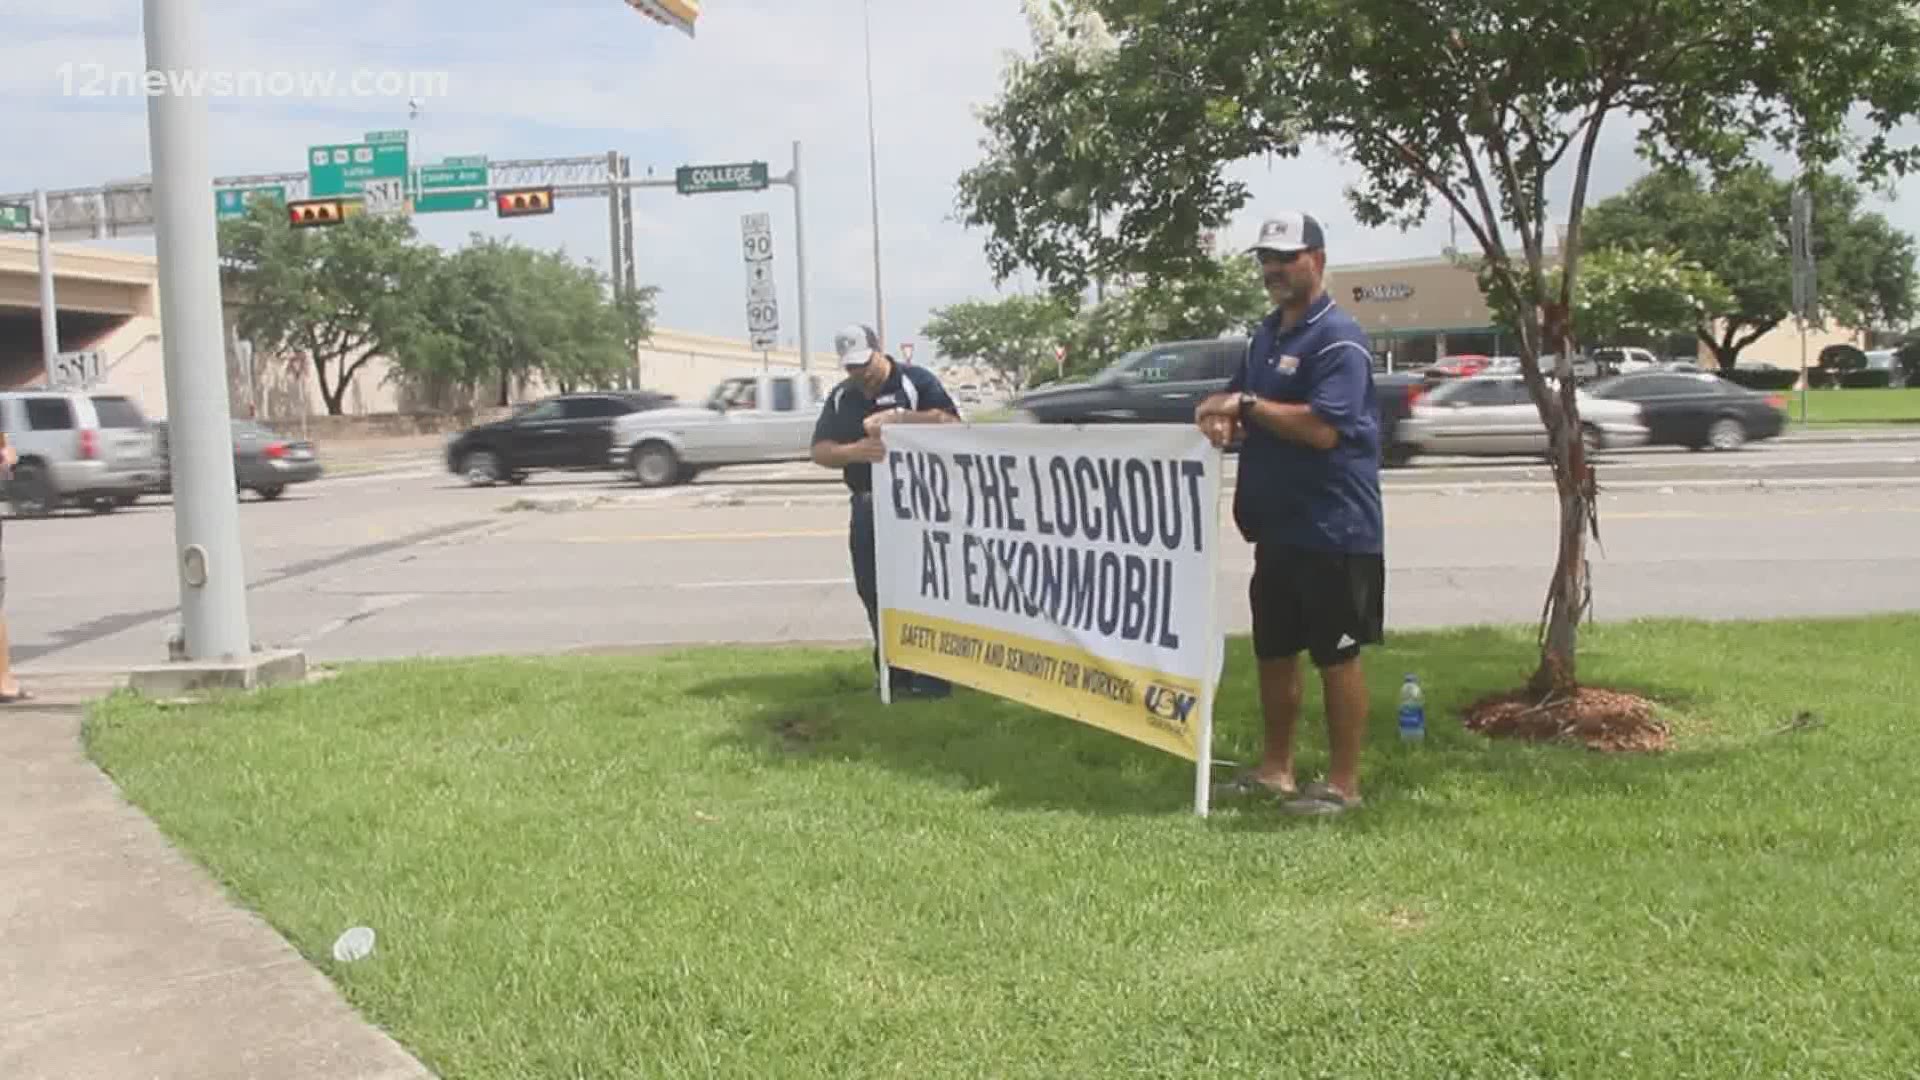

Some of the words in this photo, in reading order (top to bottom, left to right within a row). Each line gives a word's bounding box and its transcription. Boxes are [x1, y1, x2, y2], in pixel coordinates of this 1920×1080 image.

[691, 166, 752, 185] COLLEGE
[744, 236, 769, 256] 90
[751, 304, 774, 322] 90
[889, 450, 951, 523] END
[953, 453, 1025, 532] THE
[1029, 455, 1205, 553] LOCKOUT
[920, 530, 950, 601] AT
[962, 533, 1179, 649] EXXONMOBIL
[983, 641, 1005, 668] AND
[1006, 647, 1059, 681] SENIORITY
[1058, 660, 1081, 688] FOR
